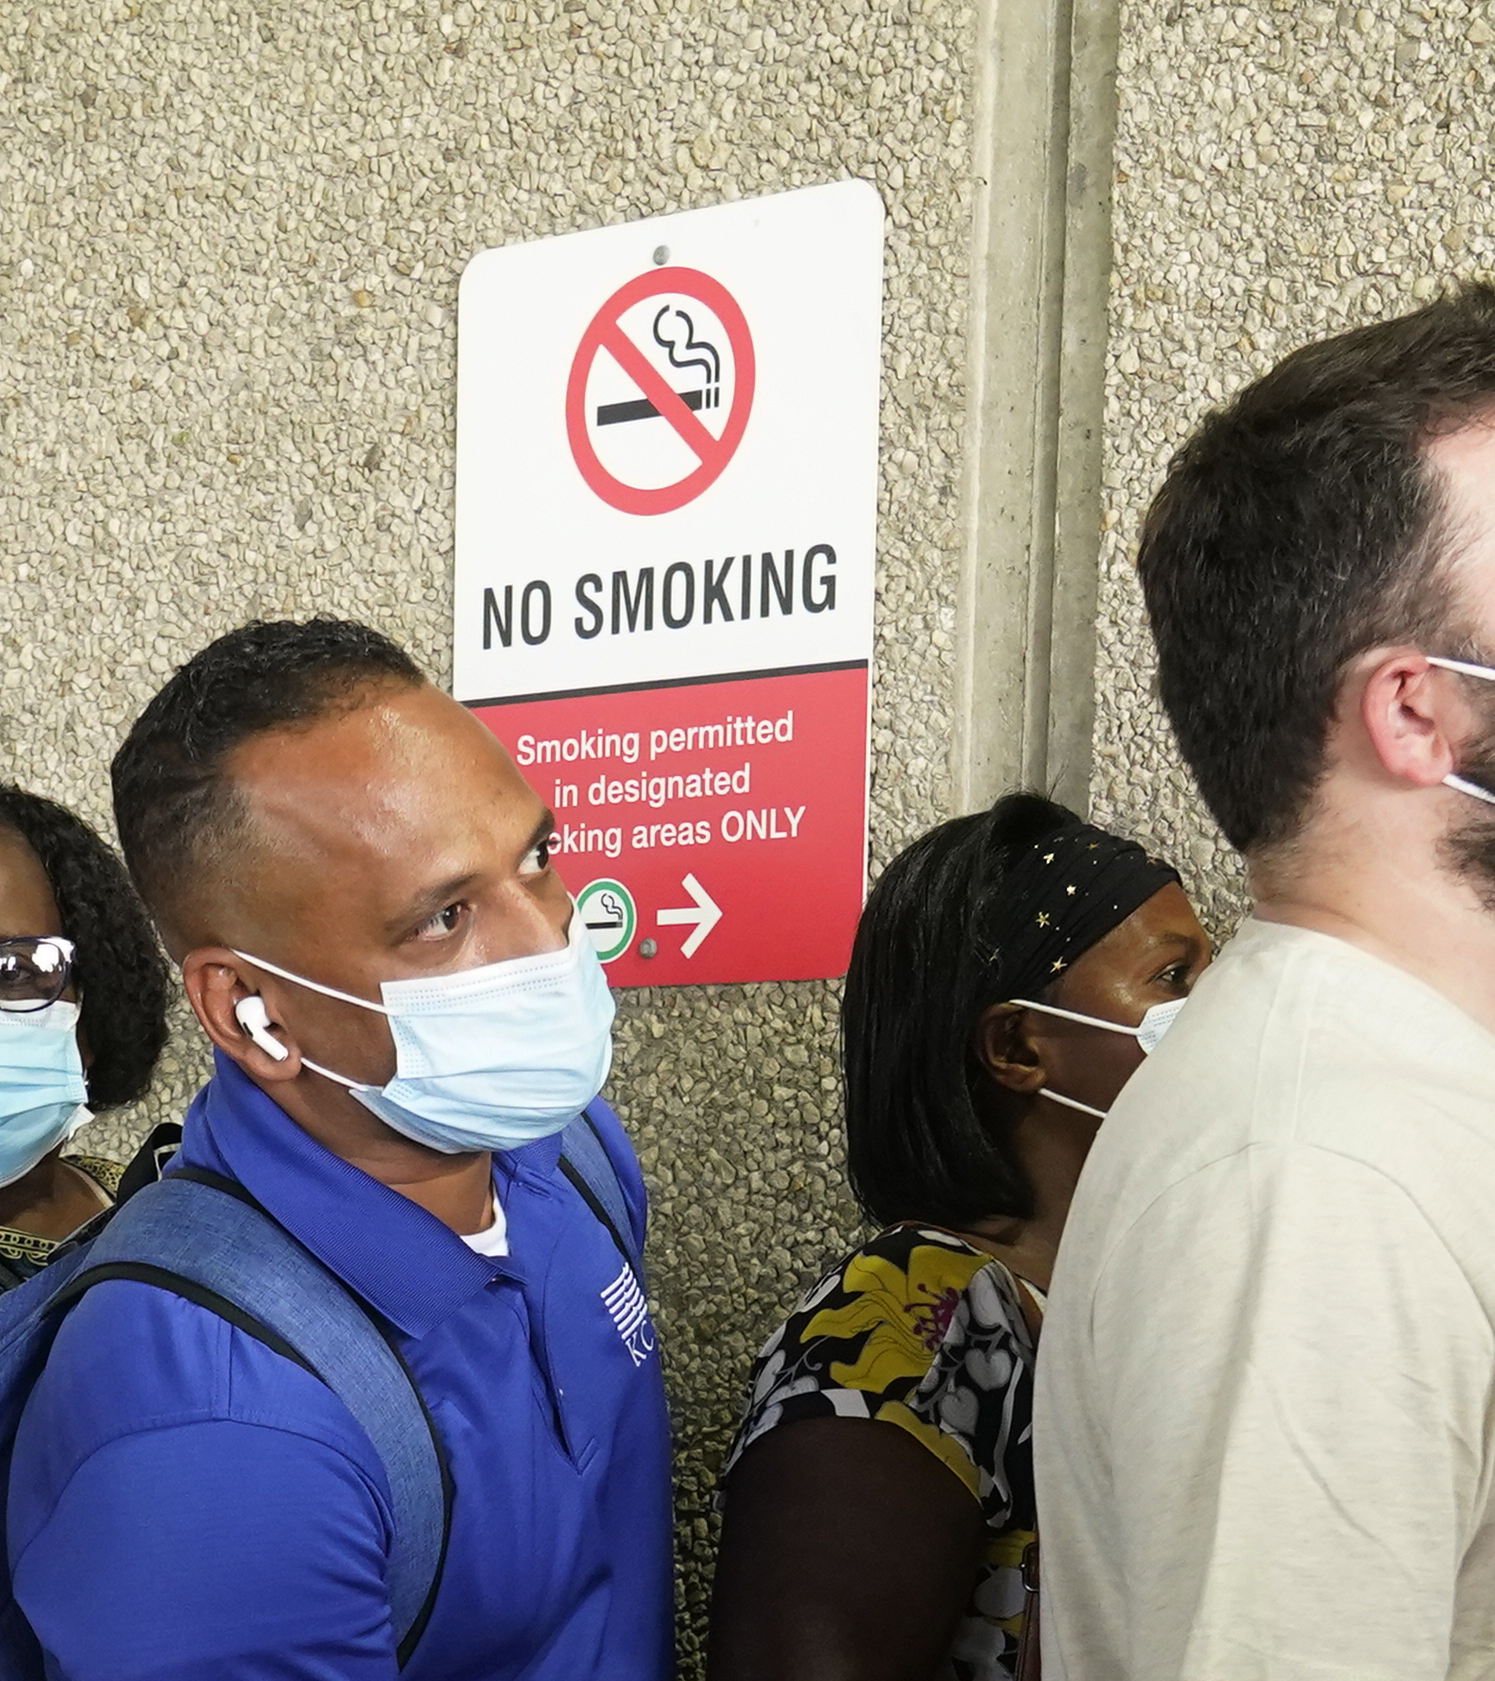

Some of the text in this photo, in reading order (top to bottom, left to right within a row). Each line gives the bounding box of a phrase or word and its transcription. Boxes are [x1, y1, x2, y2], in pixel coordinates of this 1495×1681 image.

[482, 543, 838, 650] NO SMOKING
[516, 710, 795, 765] Smoking permitted
[553, 763, 751, 808] in designated
[546, 806, 806, 858] oking areas ONLY
